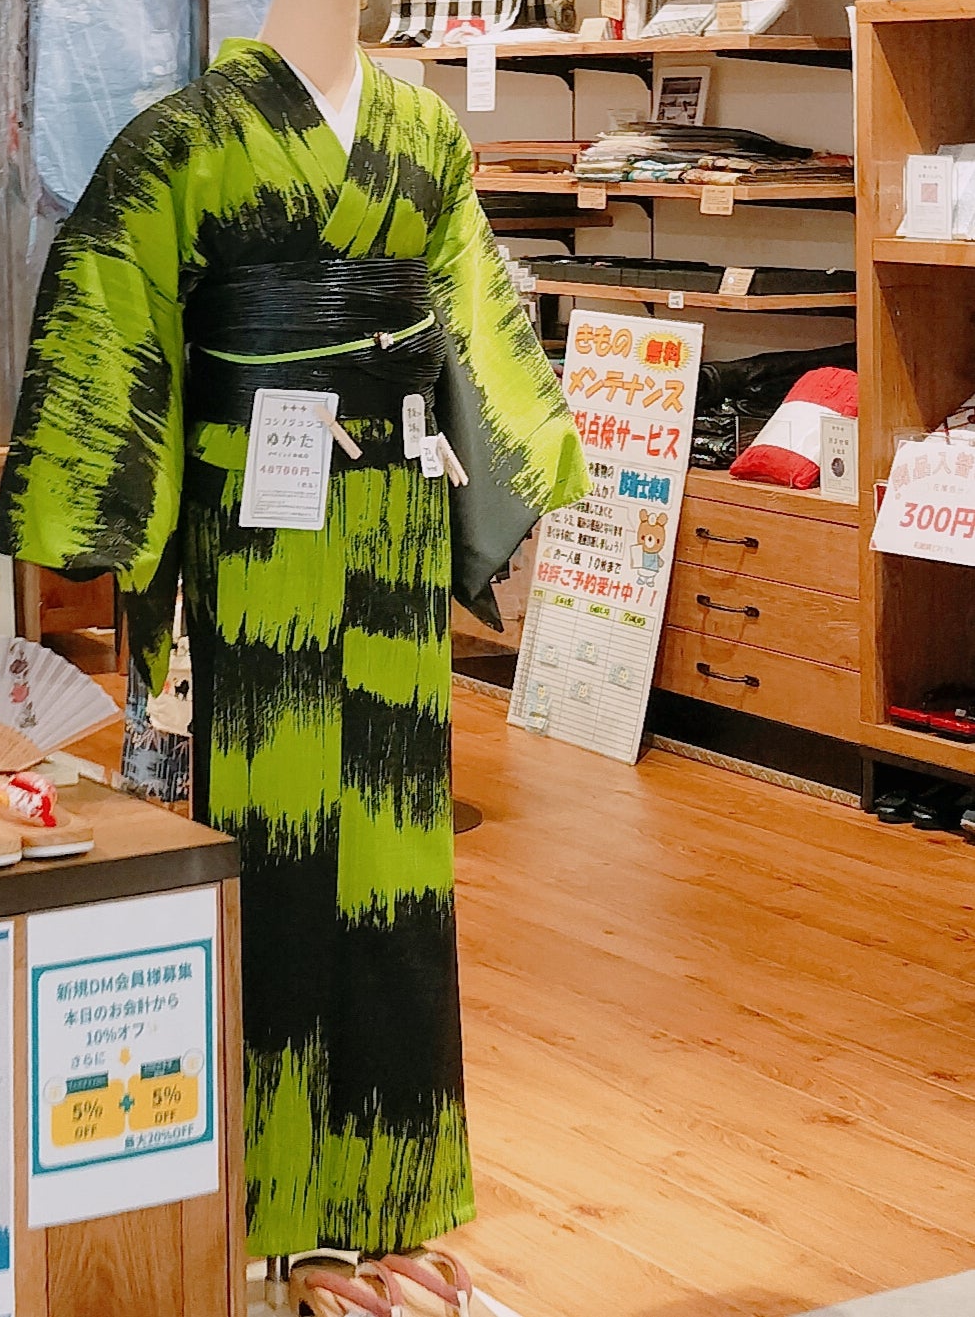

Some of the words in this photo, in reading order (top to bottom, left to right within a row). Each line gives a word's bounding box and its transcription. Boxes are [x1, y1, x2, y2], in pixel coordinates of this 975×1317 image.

[575, 323, 633, 359] きもの
[646, 339, 681, 368] 無料
[568, 367, 685, 413] メンテナンス
[264, 417, 323, 429] コシノジュンコ
[572, 410, 680, 460] 料点検サービス
[267, 432, 314, 448] ゆかた
[899, 502, 975, 538] 300円
[64, 993, 179, 1027] 本日のお会計から
[86, 1022, 144, 1047] 10%オフ
[153, 1086, 181, 1108] 5%
[73, 1098, 103, 1121] 5%
[154, 1109, 178, 1124] OFF
[75, 1124, 97, 1140] OFF
